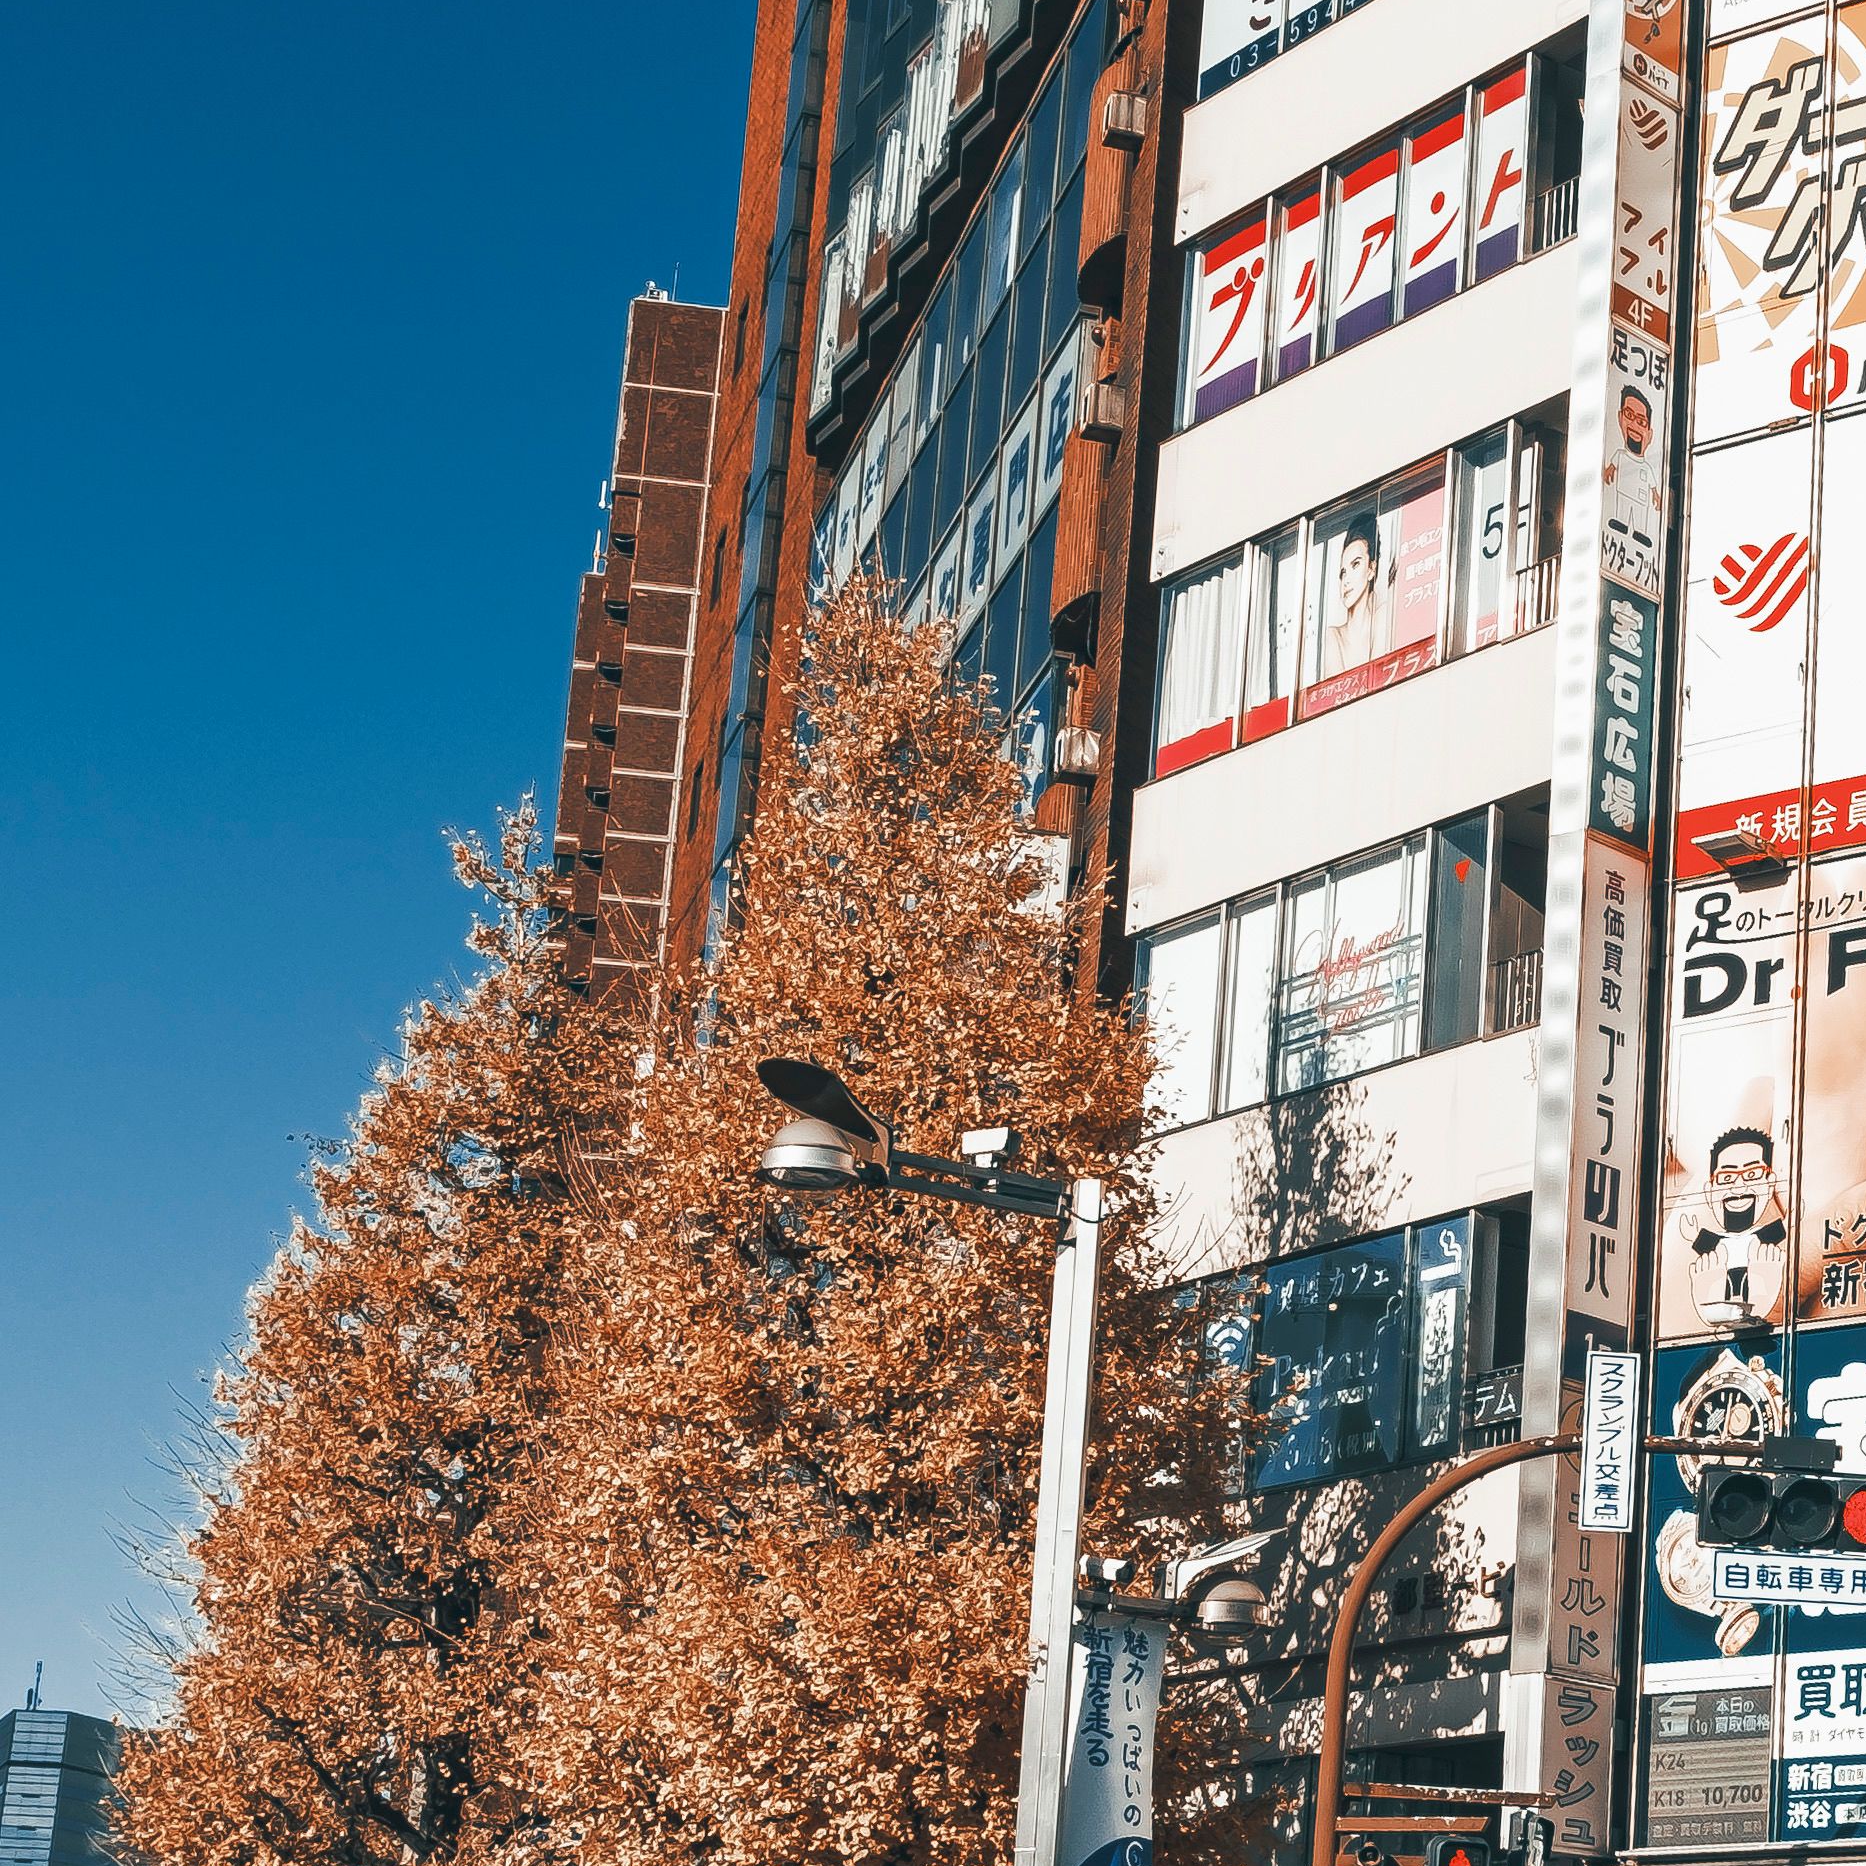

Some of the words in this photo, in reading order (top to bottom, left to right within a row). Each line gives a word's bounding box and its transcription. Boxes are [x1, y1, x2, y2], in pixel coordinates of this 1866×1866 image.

[1629, 297, 1654, 329] 4F
[1609, 334, 1668, 392] 足つぼ
[1600, 598, 1644, 834] 宝石広場
[1599, 868, 1626, 1015] 高価買取
[1593, 1362, 1627, 1521] スクランブル交差点
[1080, 1625, 1115, 1768] 新宿を走る
[1715, 1696, 1755, 1714] 本日の
[1121, 1618, 1150, 1827] 魅力いっぱいの
[1714, 1713, 1770, 1735] 買取価格
[1654, 1789, 1685, 1808] K18
[1787, 1761, 1833, 1791] 新宿
[1787, 1800, 1832, 1830] 渋谷
